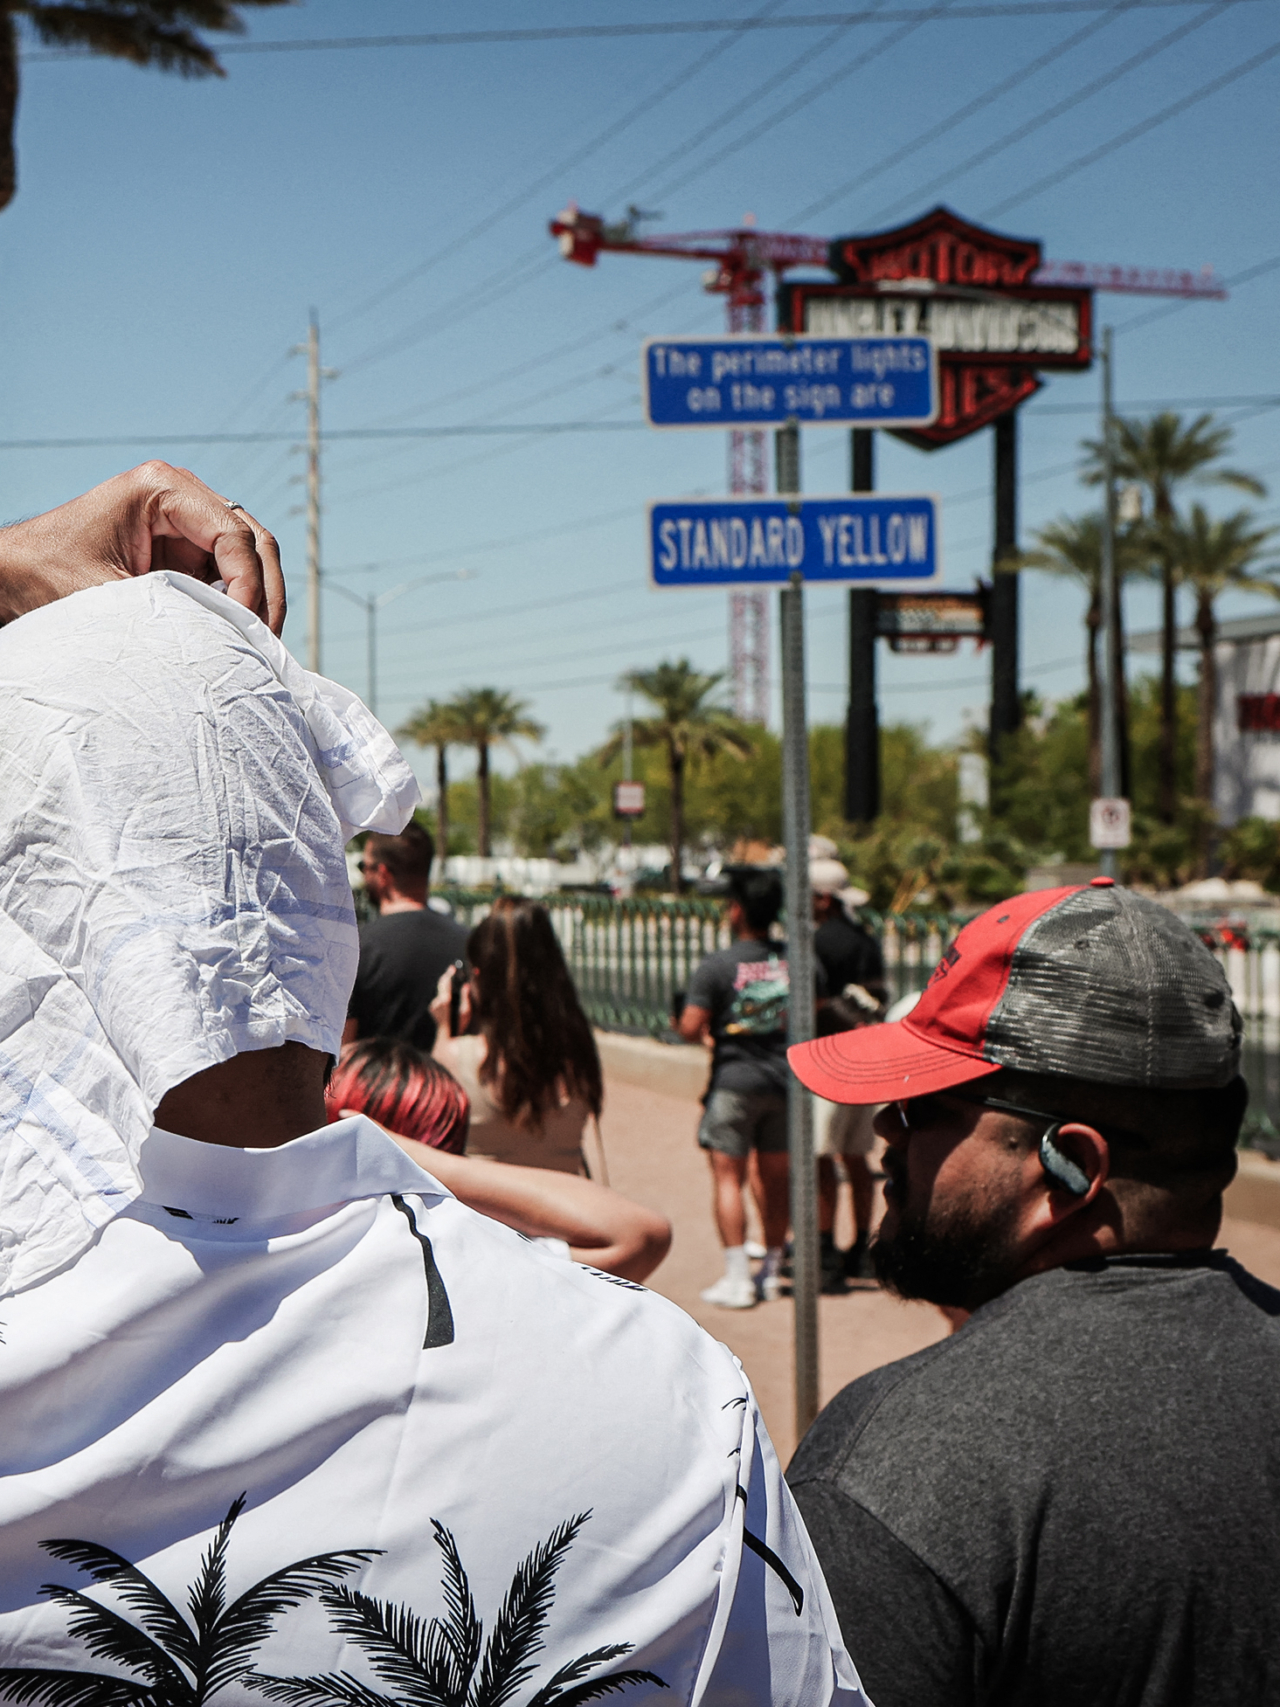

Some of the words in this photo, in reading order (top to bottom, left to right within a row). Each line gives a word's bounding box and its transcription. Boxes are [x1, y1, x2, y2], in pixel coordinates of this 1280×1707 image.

[654, 347, 702, 376] The
[711, 346, 841, 382] perimeter
[850, 345, 927, 379] lights
[686, 386, 722, 413] on
[730, 383, 776, 411] the
[783, 380, 841, 417] sign
[850, 383, 895, 409] are
[658, 515, 806, 571] STANDARD
[817, 513, 929, 567] YELLOW
